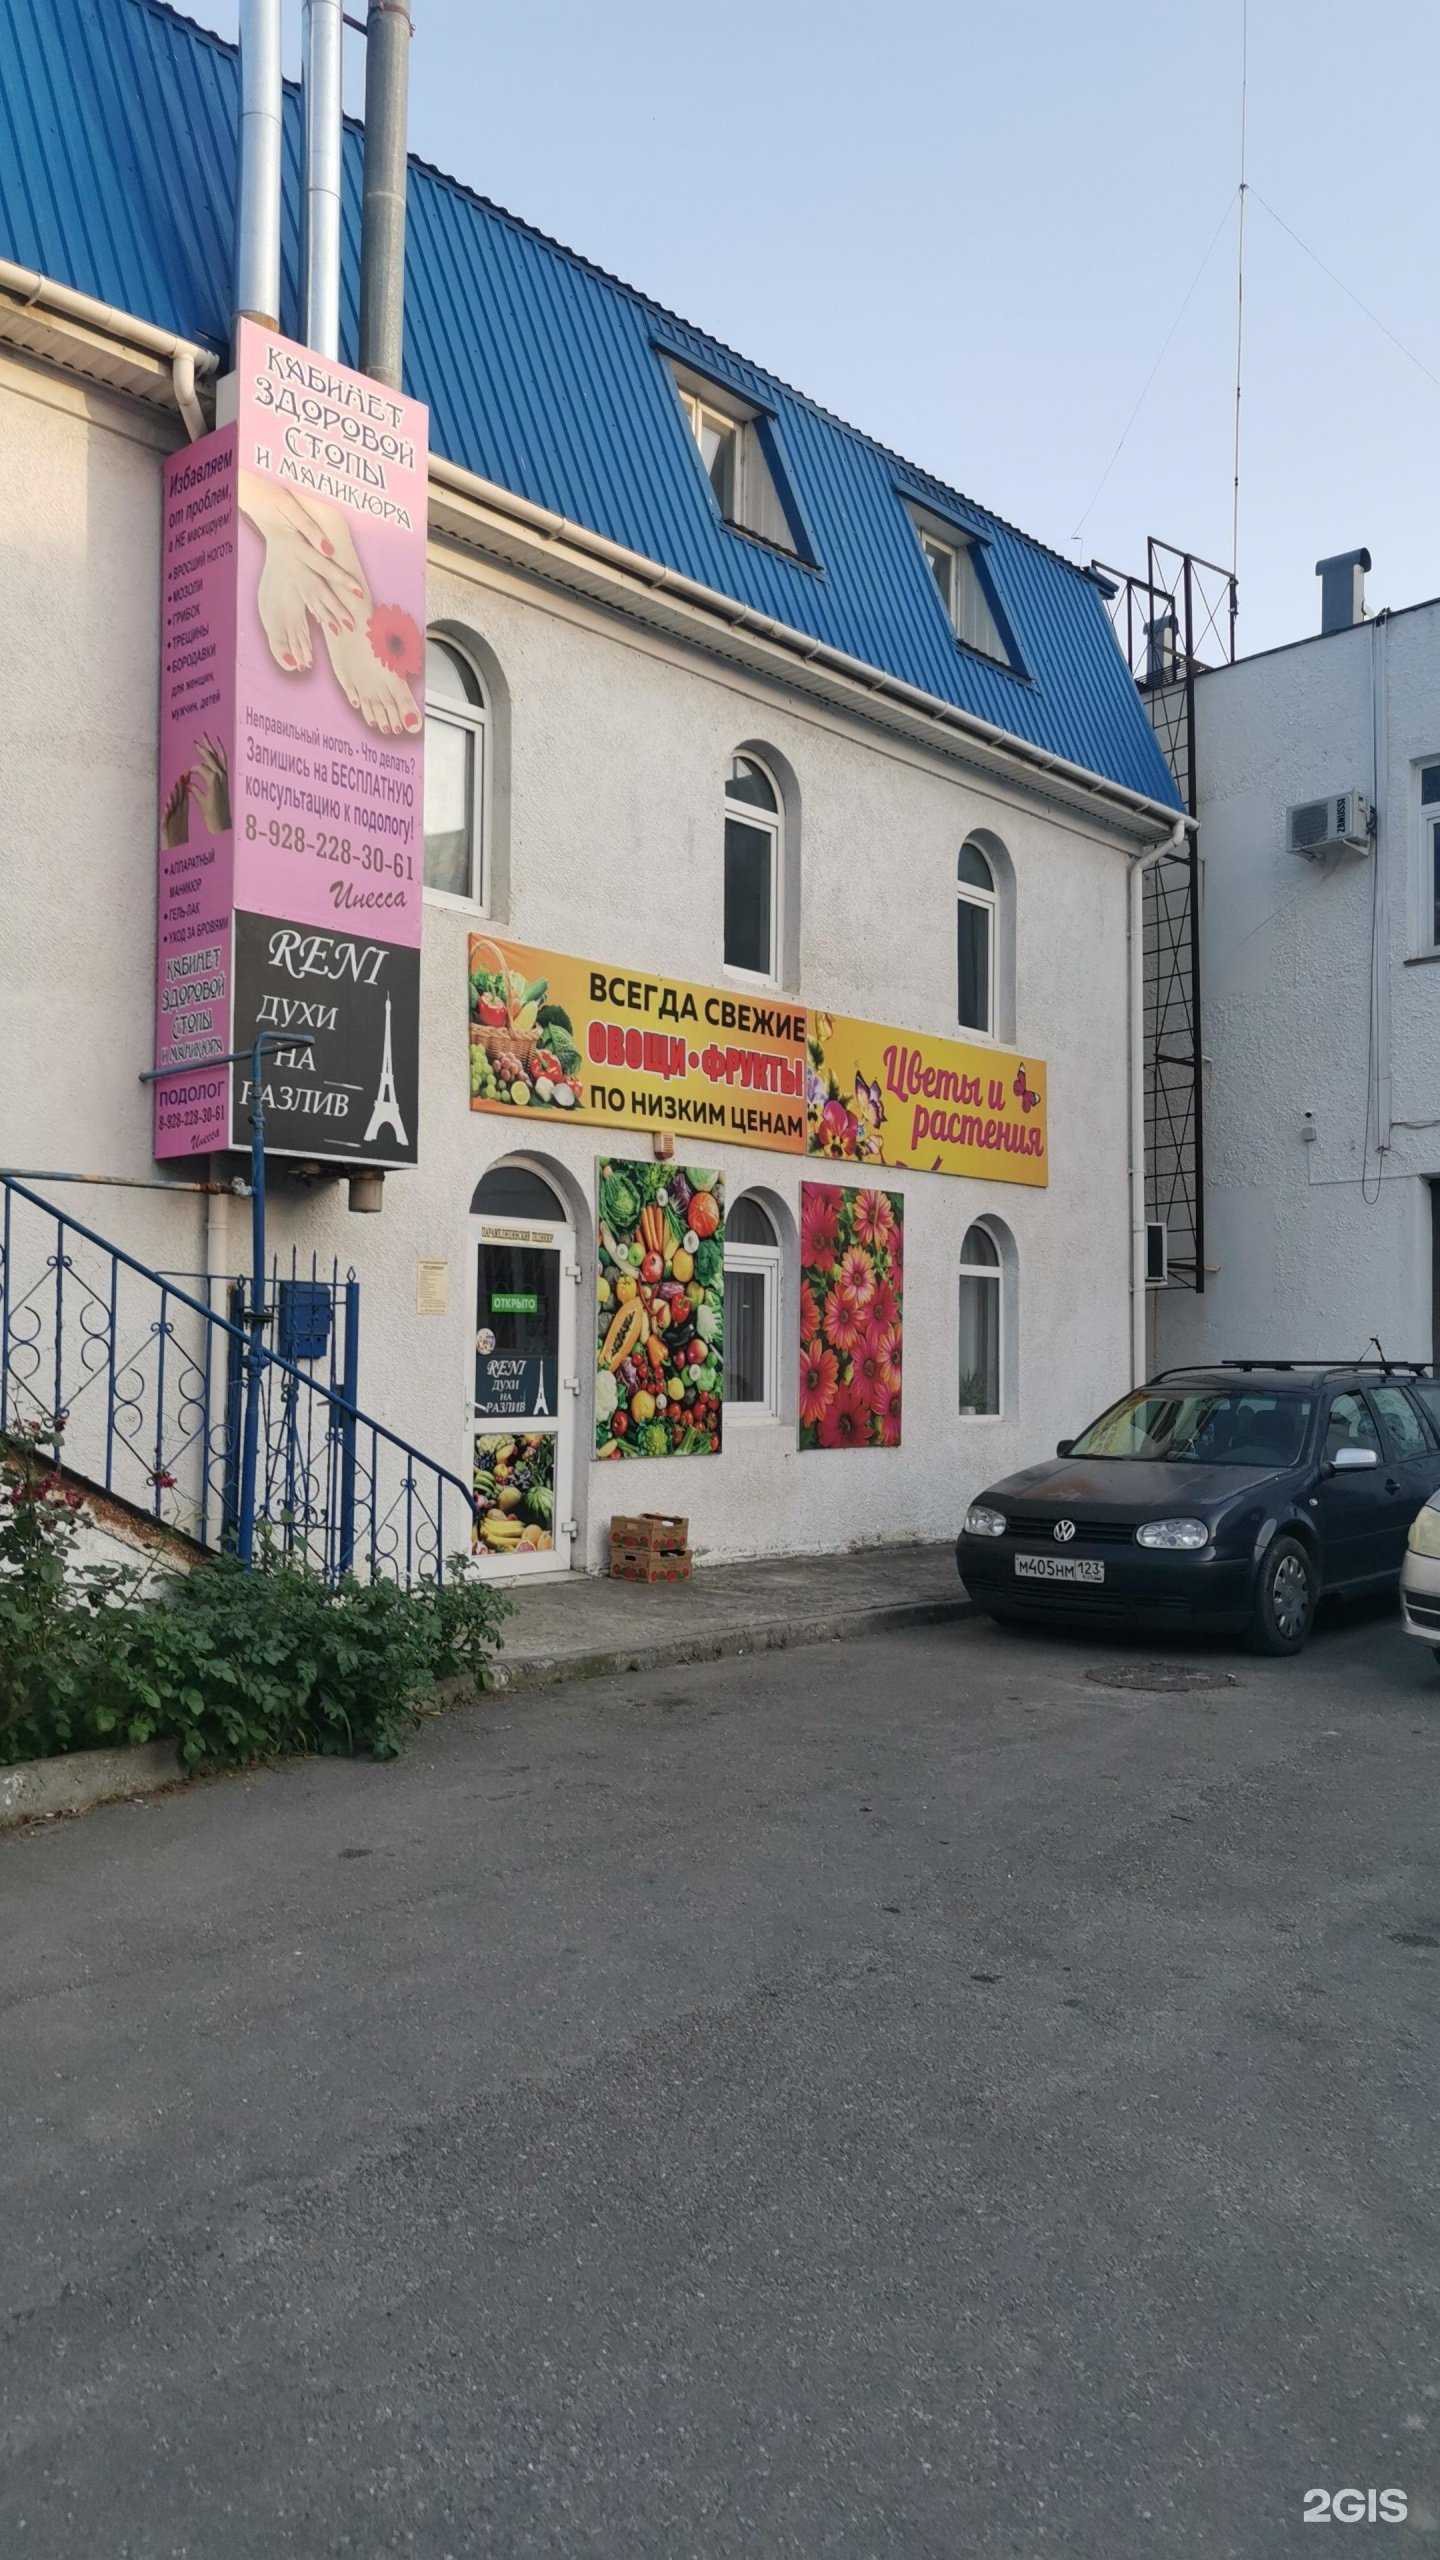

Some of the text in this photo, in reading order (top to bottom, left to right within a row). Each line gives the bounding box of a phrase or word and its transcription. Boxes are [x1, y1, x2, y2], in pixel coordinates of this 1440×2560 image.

[268, 347, 403, 429] КАБИНЕТ
[256, 377, 414, 468] ЗДОРОВОЙ
[169, 449, 233, 498] Избавляем
[285, 426, 386, 490] СТОПЫ
[257, 446, 412, 529] И МАНИКЮРА
[168, 508, 184, 529] от
[172, 604, 200, 626] ГРИБОК
[172, 623, 209, 649] ТРЕЩИНЫ
[172, 642, 216, 673] БОРОДАВКИ
[246, 706, 320, 746] Неправильный
[322, 733, 353, 756] ноготь
[361, 741, 378, 764] Что
[379, 752, 415, 775] делать?
[246, 735, 414, 808] Запишись на БЕСПЛАТНУЮ
[245, 775, 415, 845] консультацию к подологу!
[245, 814, 414, 881] 8-928-228-30-61
[329, 880, 408, 910] Инесса
[167, 948, 222, 983] КАБИНЕТ
[268, 929, 390, 986] RENI
[162, 976, 225, 1011] ЗДОРОВОЙ
[589, 972, 805, 1043] ВСЕГДА СВЕЖИЕ
[171, 1011, 213, 1040] СТОПЫ
[255, 994, 339, 1031] ДУХИ
[273, 1043, 317, 1071] НА
[159, 1080, 225, 1108] ПОДОЛОГ
[883, 1045, 1006, 1111] Цветы и
[591, 1085, 804, 1138] ПО НИЗКИМ ЦЕНАМ
[911, 1103, 1044, 1158] растения
[493, 1297, 537, 1310] ОТКРЫТО
[486, 1360, 528, 1378] RENI
[492, 1379, 520, 1392] ДУХИ
[486, 1402, 526, 1413] РАЗЛИВ
[499, 1393, 512, 1401] НА
